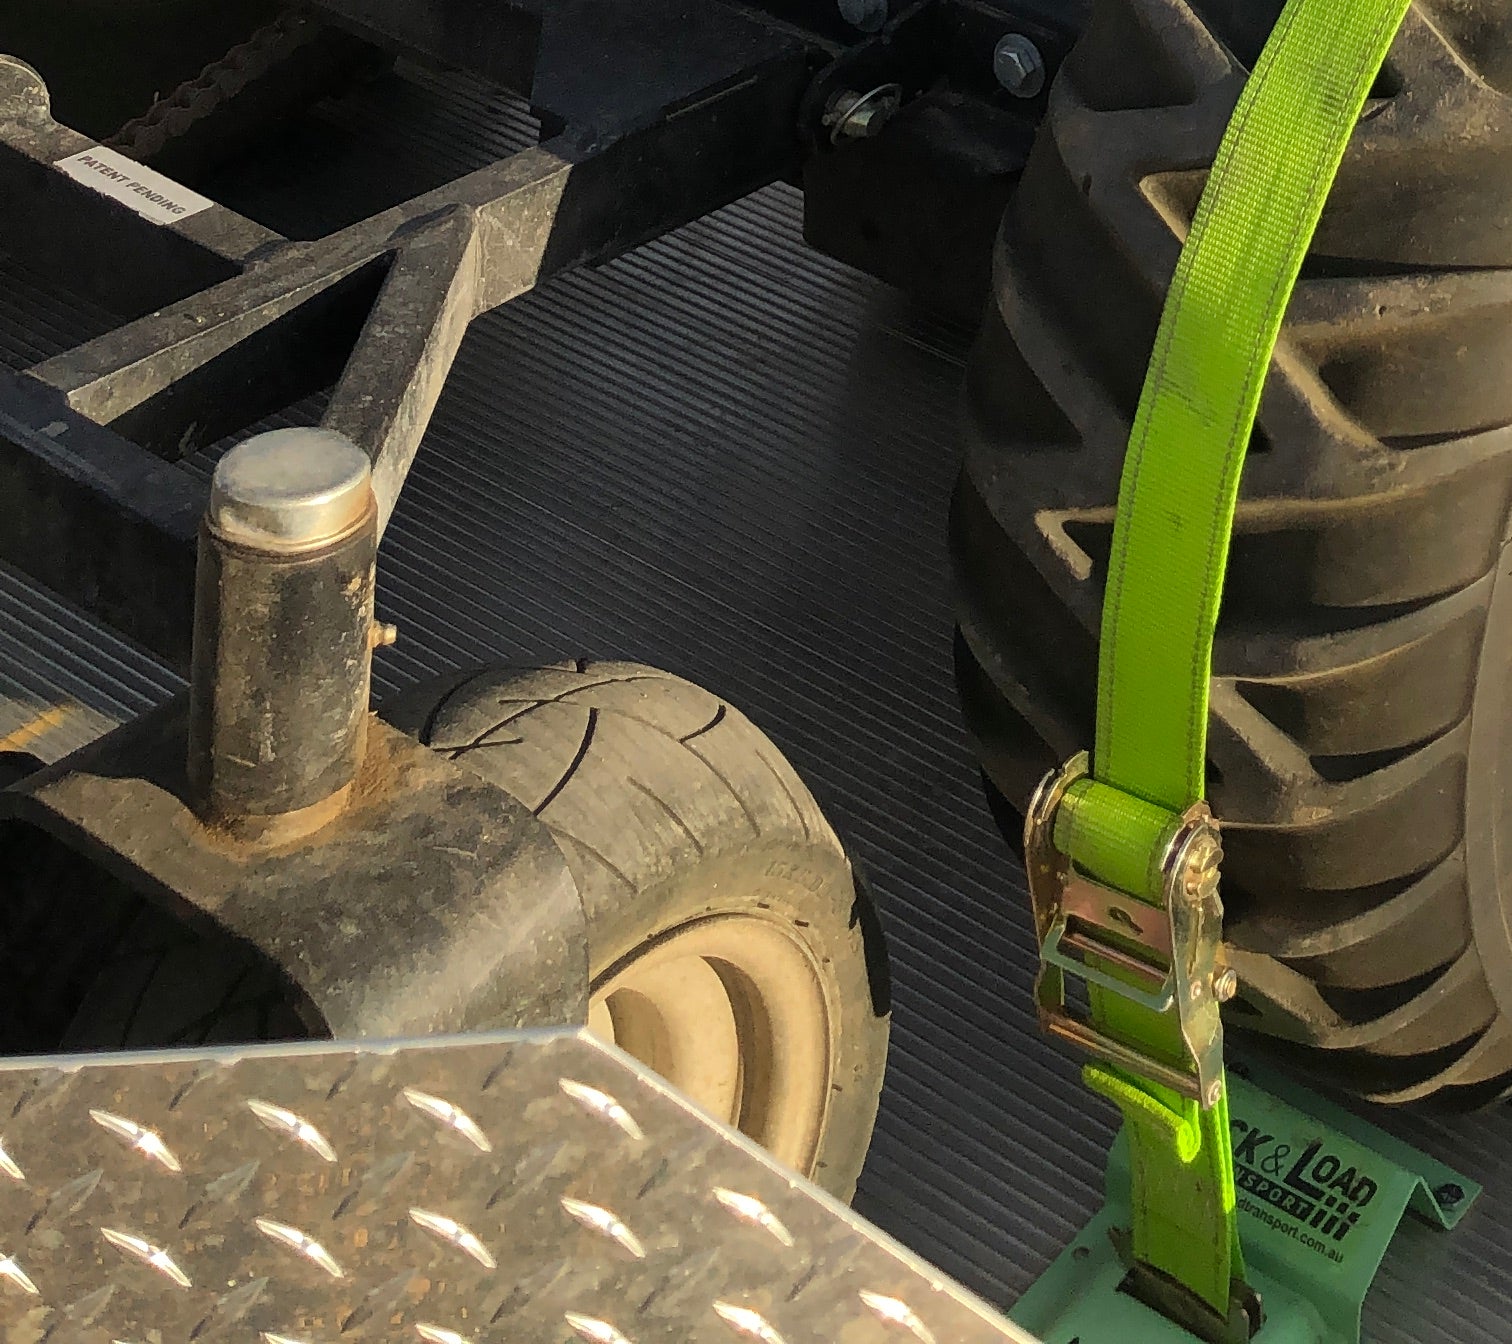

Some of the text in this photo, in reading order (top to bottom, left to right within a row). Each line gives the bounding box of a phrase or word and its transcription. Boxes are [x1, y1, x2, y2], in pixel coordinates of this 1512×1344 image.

[77, 155, 187, 215] PATENT PENDING
[1260, 1144, 1291, 1177] &
[1282, 1137, 1378, 1208] LOAD
[1237, 1197, 1345, 1264] dtransport.com.au
